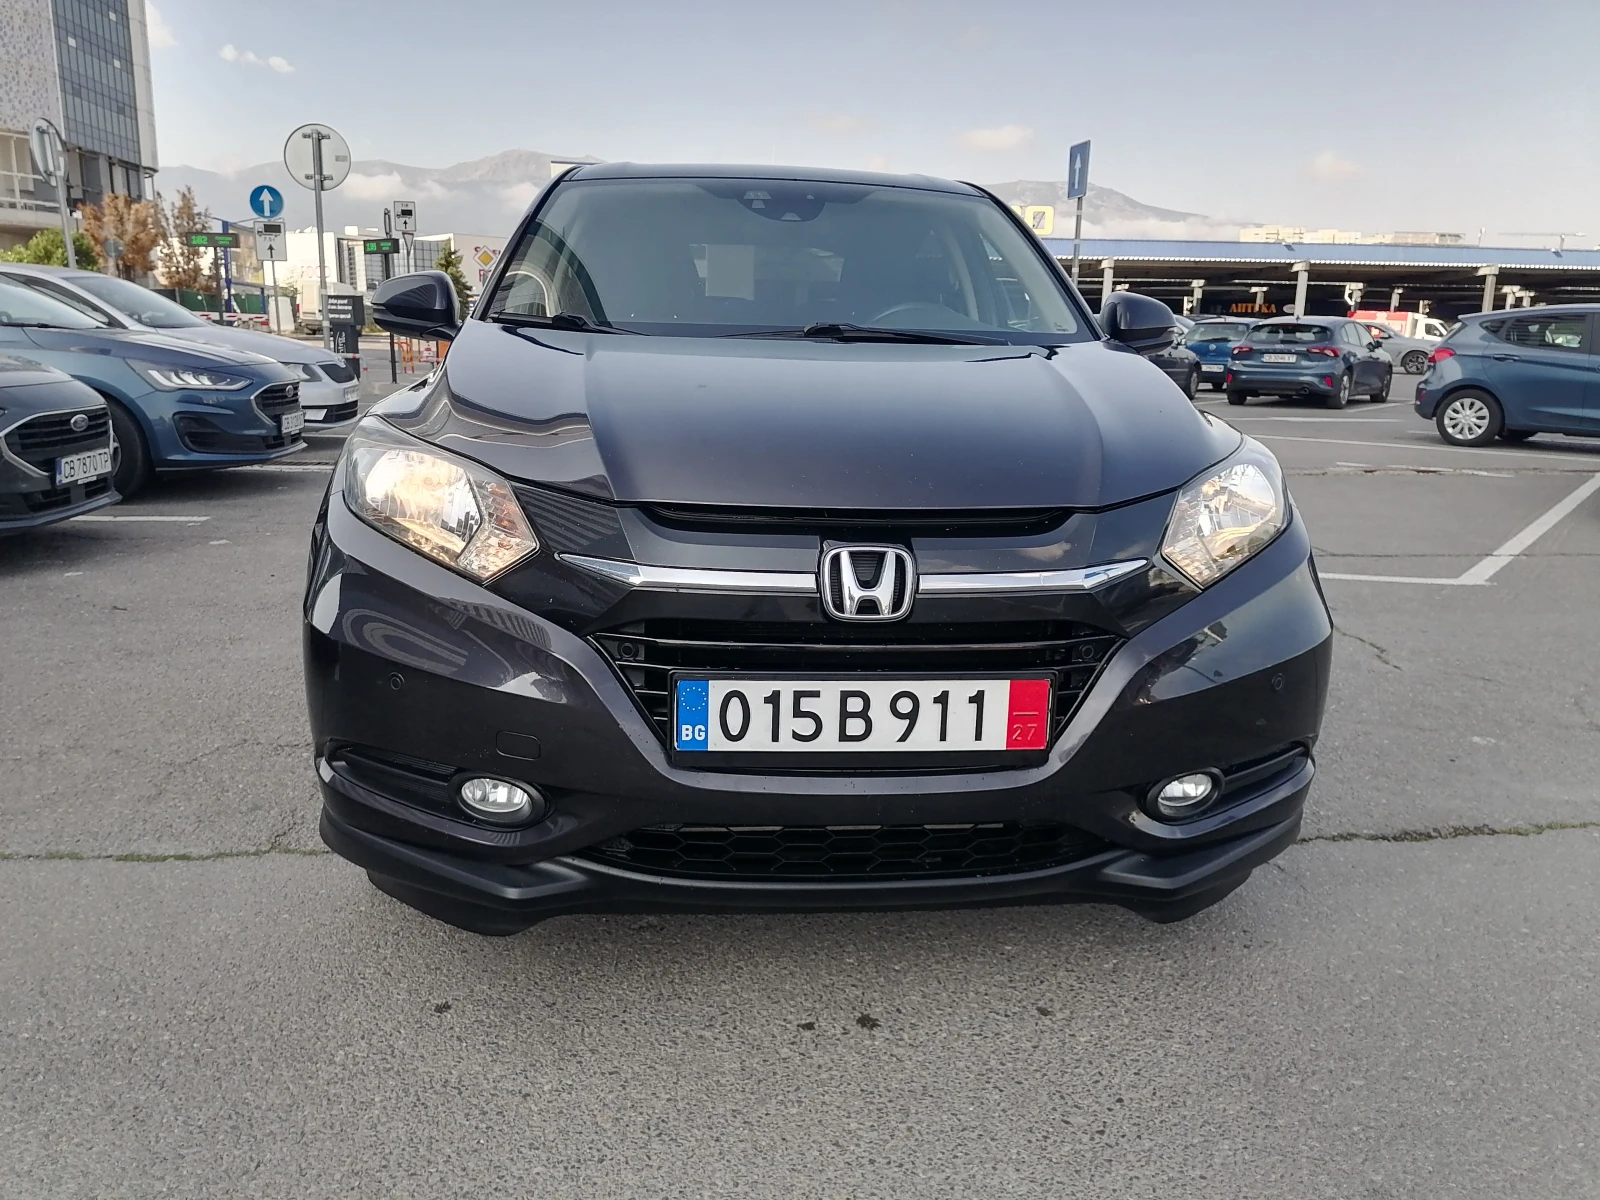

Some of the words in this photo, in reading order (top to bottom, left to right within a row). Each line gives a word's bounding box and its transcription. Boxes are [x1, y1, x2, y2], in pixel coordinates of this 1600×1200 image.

[63, 460, 76, 479] CB
[77, 454, 98, 475] 7870
[98, 451, 109, 471] TP
[718, 689, 986, 743] 015B911
[681, 724, 706, 741] BG
[1011, 723, 1037, 742] 27
